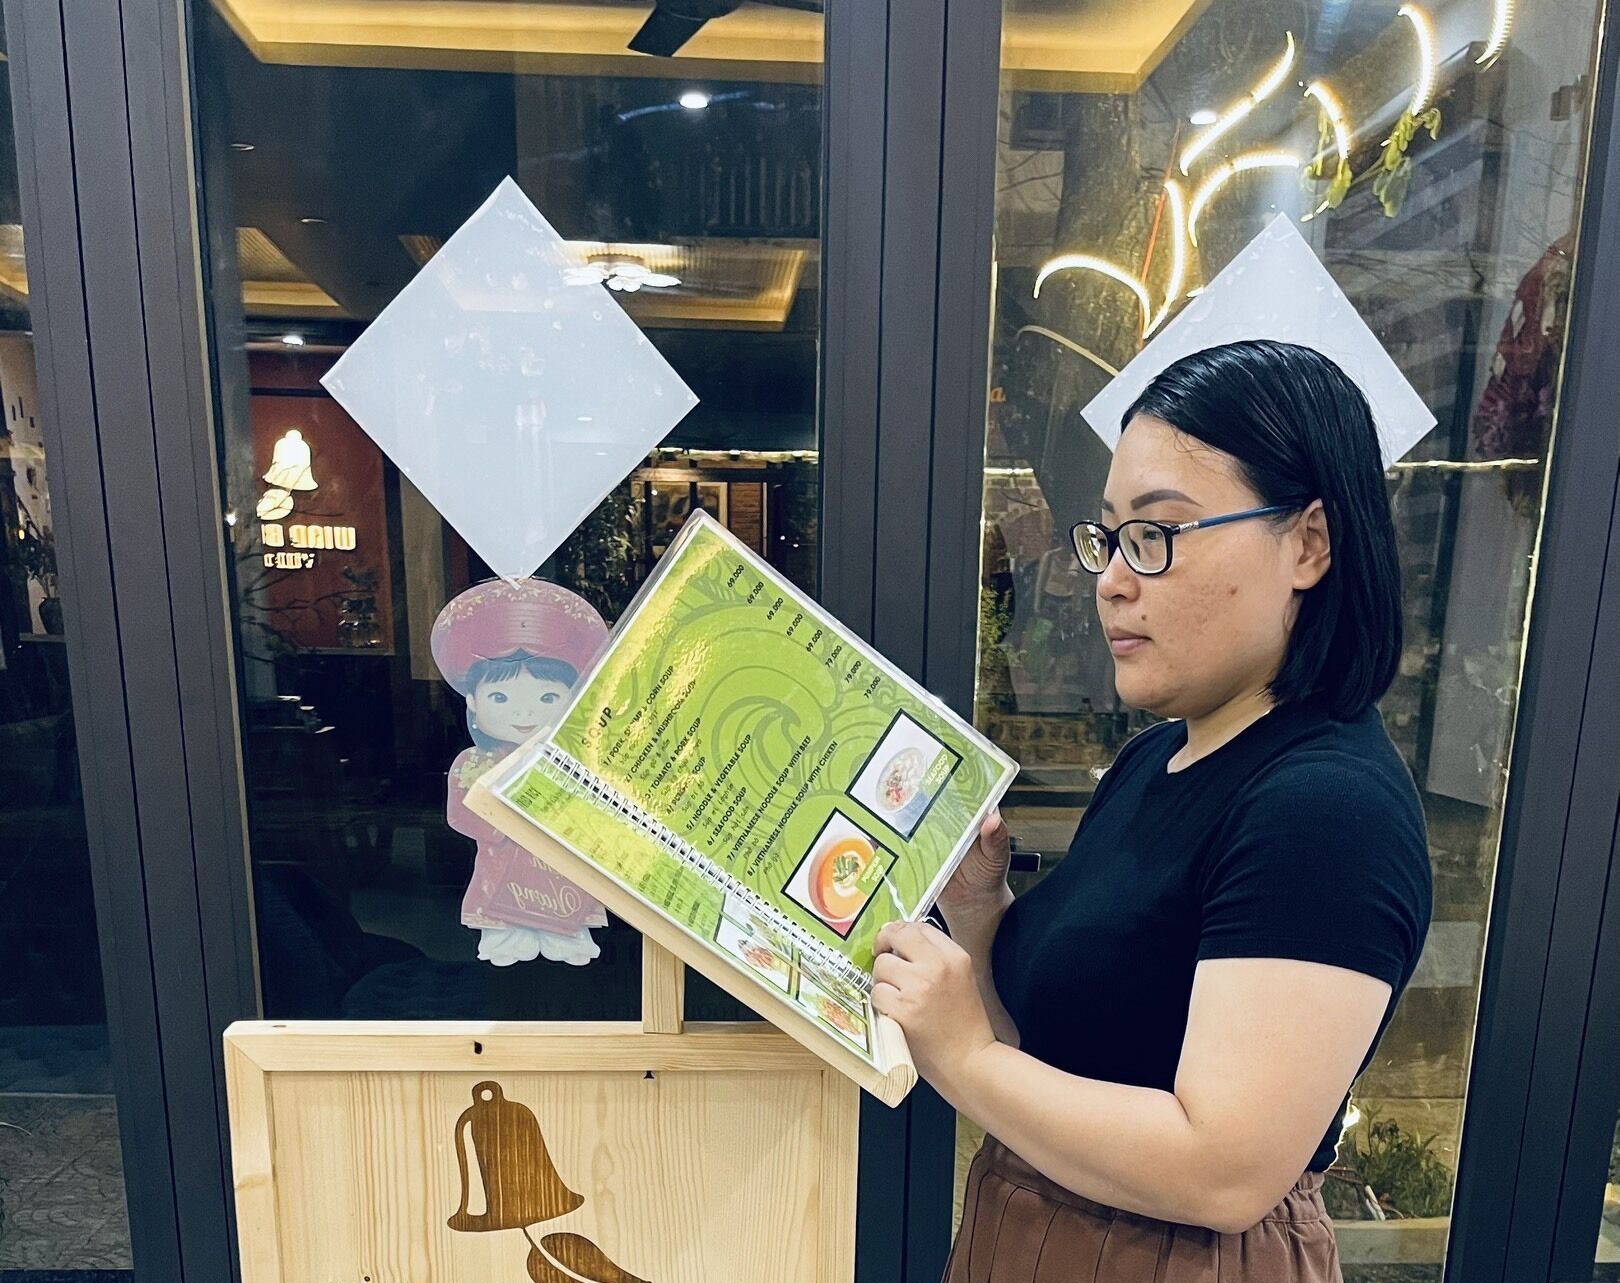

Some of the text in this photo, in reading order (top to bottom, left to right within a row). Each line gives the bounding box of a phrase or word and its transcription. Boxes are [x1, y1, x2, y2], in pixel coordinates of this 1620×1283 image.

[725, 563, 745, 588] 69.000
[745, 580, 765, 605] 69.000
[765, 596, 784, 621] 69.000
[784, 612, 804, 636] 69.000
[804, 628, 824, 652] 69.000
[823, 643, 843, 668] 79.000
[843, 659, 862, 683] 79.000
[644, 683, 662, 705] CORN
[657, 663, 676, 685] SOUP
[862, 674, 882, 699] 79.000
[685, 716, 703, 737] SOUP
[629, 741, 655, 774] CHICKEN
[668, 754, 677, 762] &
[672, 735, 690, 756] PORK
[650, 760, 673, 790] TOMATO
[690, 755, 707, 776] SOUP
[684, 820, 695, 831] 5/
[690, 792, 713, 821] NOODLE
[713, 751, 741, 787] VEGETABLE
[736, 732, 753, 753] SOUP
[725, 734, 813, 862] 7/ VIETNAMESE NOODLE SOUP WITH BEEF
[745, 739, 838, 877] 8/ VIETNAMESE NOODLE SOUP WITH CHIKEN
[705, 785, 748, 846] 6/ SEAFOOD SOUP
